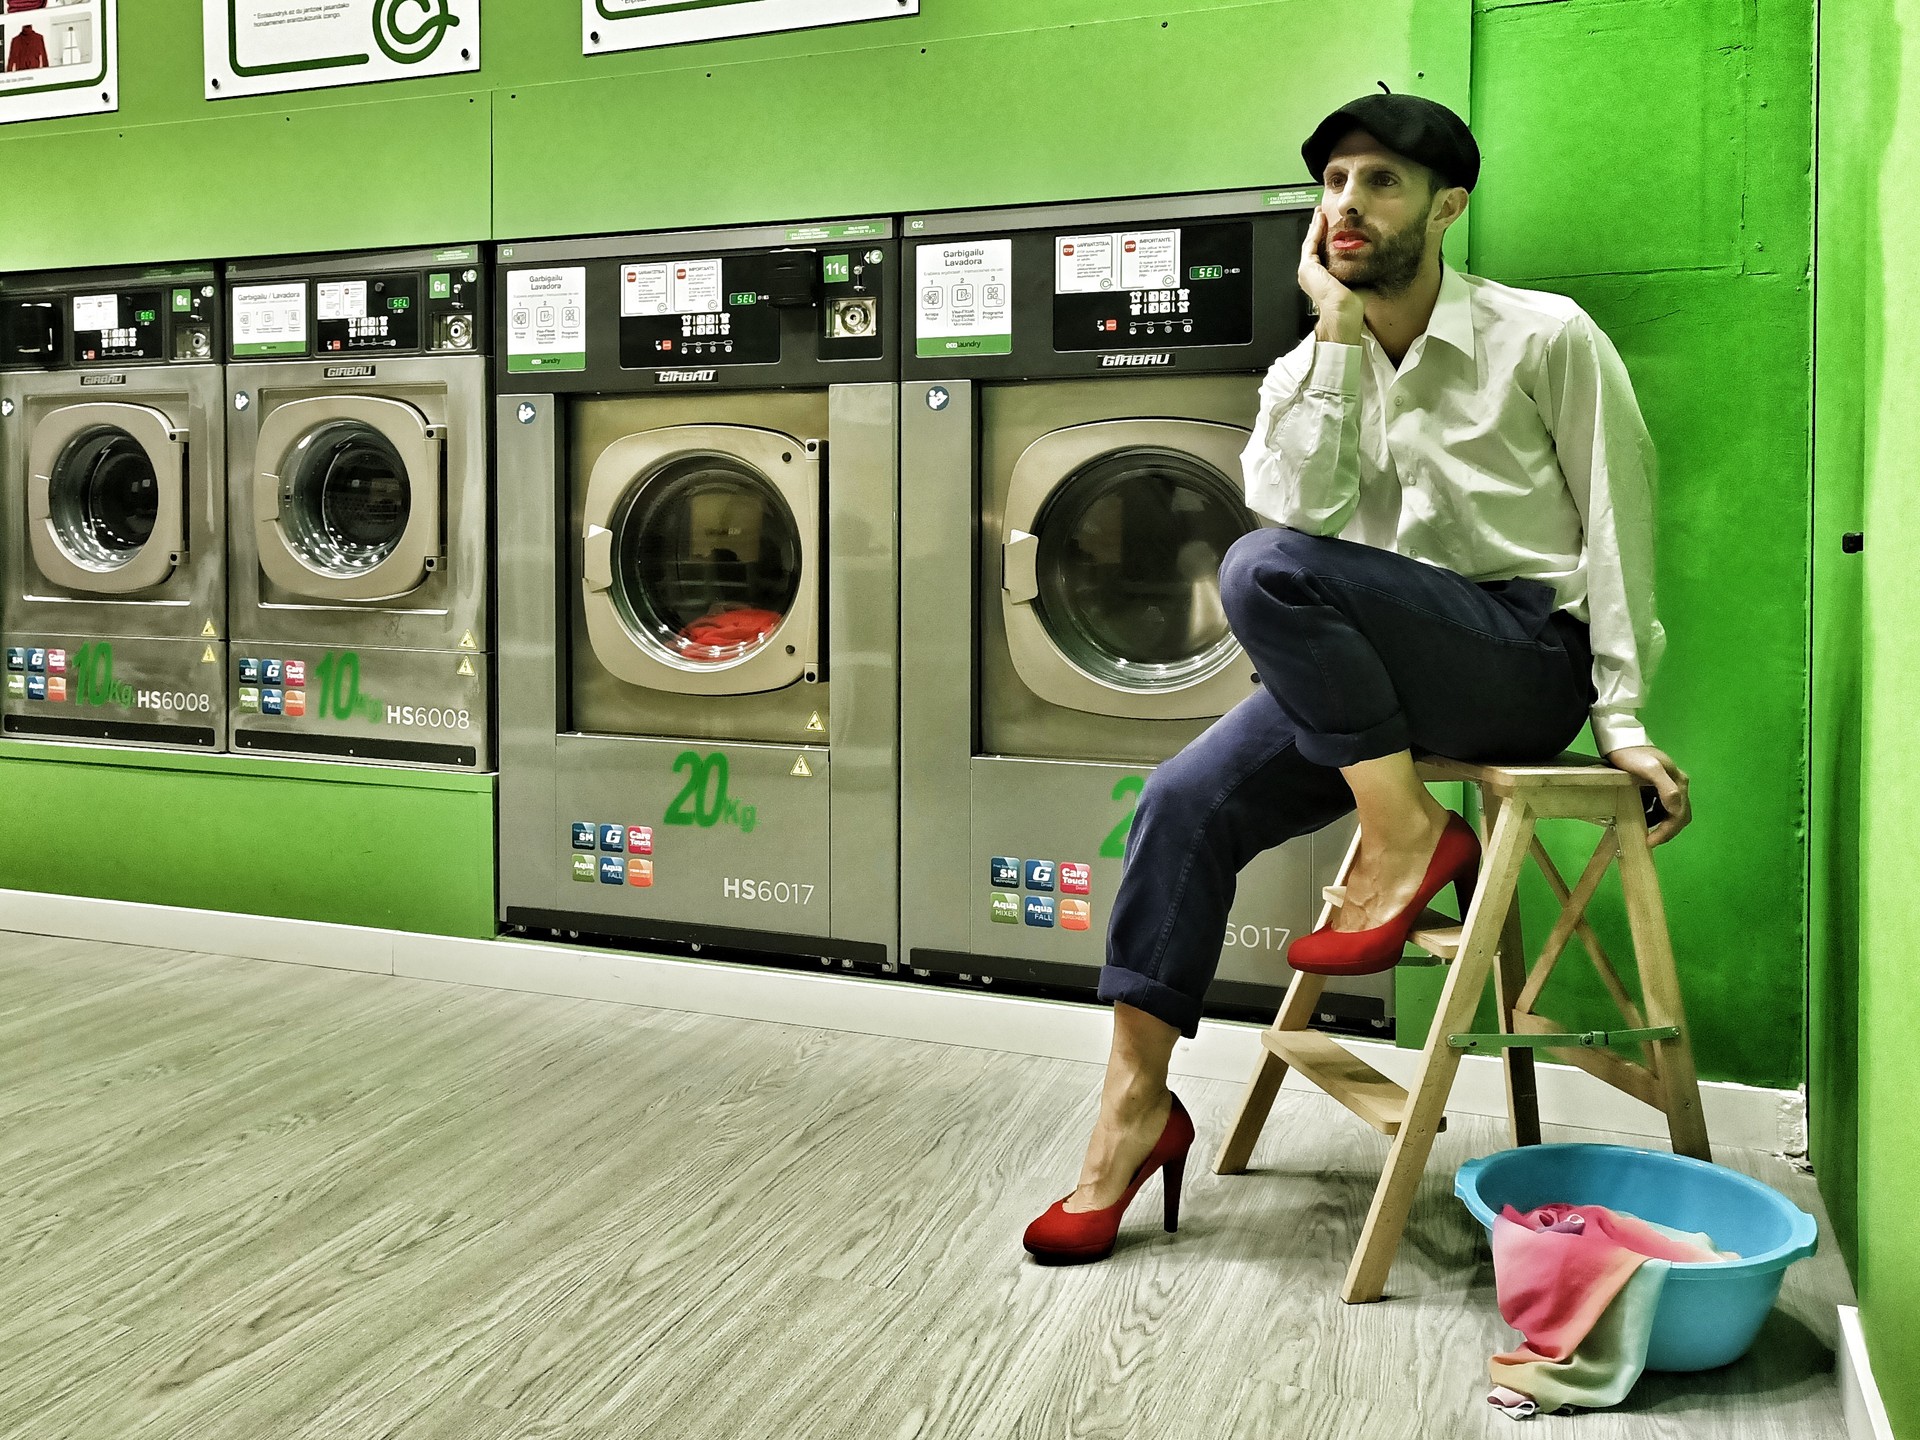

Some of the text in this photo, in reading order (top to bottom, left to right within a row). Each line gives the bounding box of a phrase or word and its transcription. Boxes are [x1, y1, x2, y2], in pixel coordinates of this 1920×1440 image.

[911, 220, 924, 229] G2
[503, 248, 513, 256] G1
[943, 249, 984, 258] Garbigailu
[944, 258, 983, 267] Lavadora
[825, 262, 848, 276] 11€
[1199, 268, 1219, 277] SEL
[529, 274, 563, 283] Garbigailu
[531, 283, 562, 291] Lavadora
[238, 293, 267, 301] Garbigailu
[737, 294, 754, 304] SEL
[393, 299, 407, 307] SEL
[1101, 354, 1170, 366] GIRBAU
[327, 366, 372, 377] GIRBAU
[657, 370, 716, 382] GIRBAU
[83, 375, 123, 385] GIRBAU
[31, 653, 43, 665] G
[266, 665, 280, 677] G
[137, 690, 210, 712] HS6008
[387, 705, 469, 729] HS6008
[1098, 775, 1146, 859] 2
[579, 832, 593, 842] SM
[605, 830, 621, 844] G
[630, 831, 651, 840] Care
[630, 839, 651, 847] Touch
[574, 861, 594, 870] Aqua
[602, 863, 623, 872] Aqua
[1000, 869, 1017, 879] SM
[1032, 866, 1052, 882] G
[1061, 868, 1088, 878] Care
[1062, 877, 1088, 886] Touch
[723, 877, 815, 905] HS6017
[993, 900, 1018, 910] Aqua
[1027, 903, 1053, 913] Aqua
[1034, 913, 1053, 921] FALL
[1223, 922, 1291, 951] 6017
